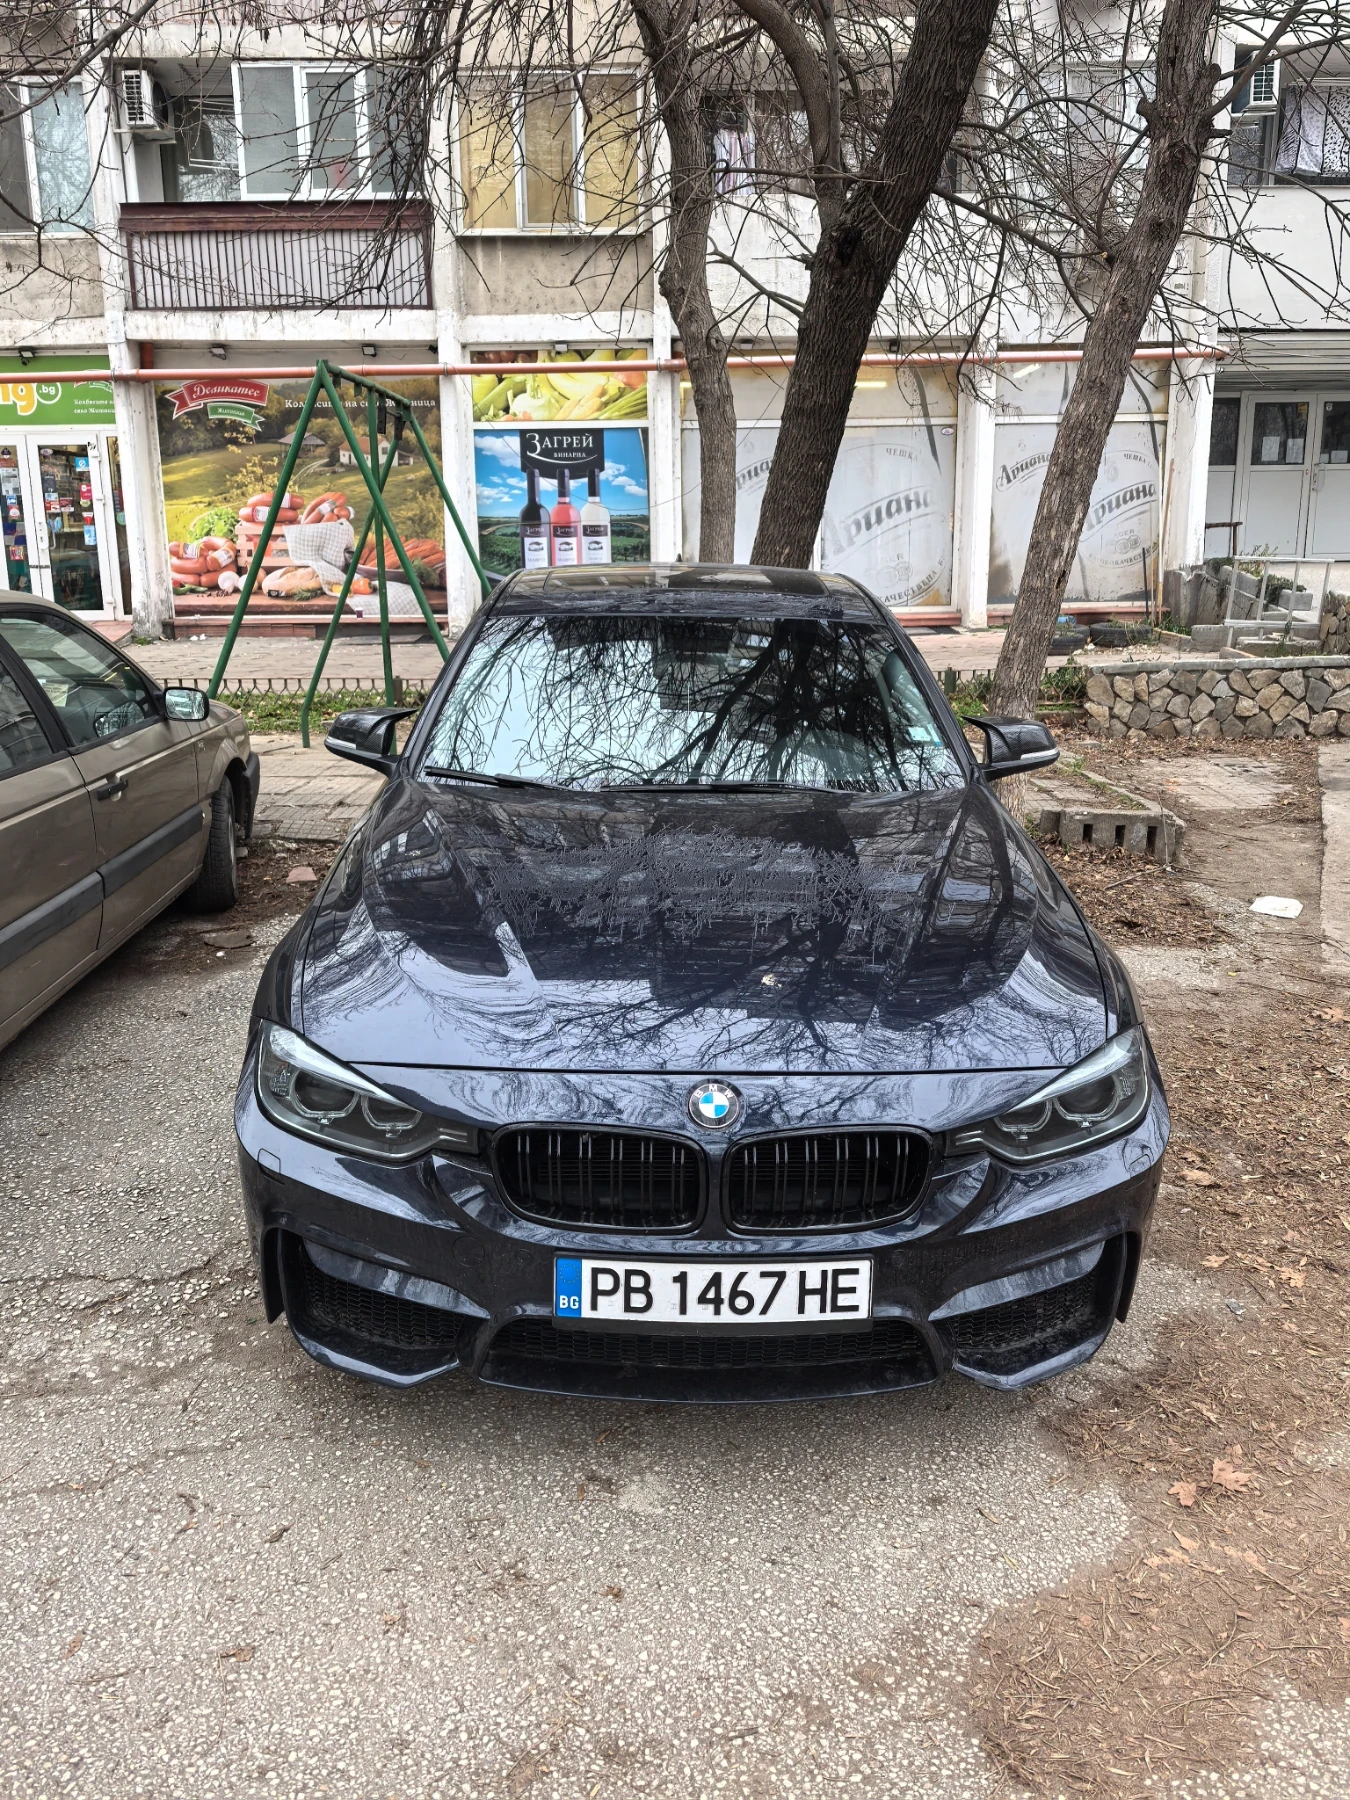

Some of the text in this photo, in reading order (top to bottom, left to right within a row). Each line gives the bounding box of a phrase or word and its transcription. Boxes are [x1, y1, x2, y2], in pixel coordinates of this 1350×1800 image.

[39, 384, 55, 395] .bg
[192, 384, 260, 398] Деликатес
[345, 400, 358, 408] на
[385, 399, 436, 408] Жница
[526, 432, 594, 456] ЗАГРЕЙ
[1123, 453, 1147, 464] ЧЕШКА
[694, 1084, 734, 1098] BMW
[590, 1266, 860, 1316] PB 1467 HE
[559, 1295, 579, 1310] BG
